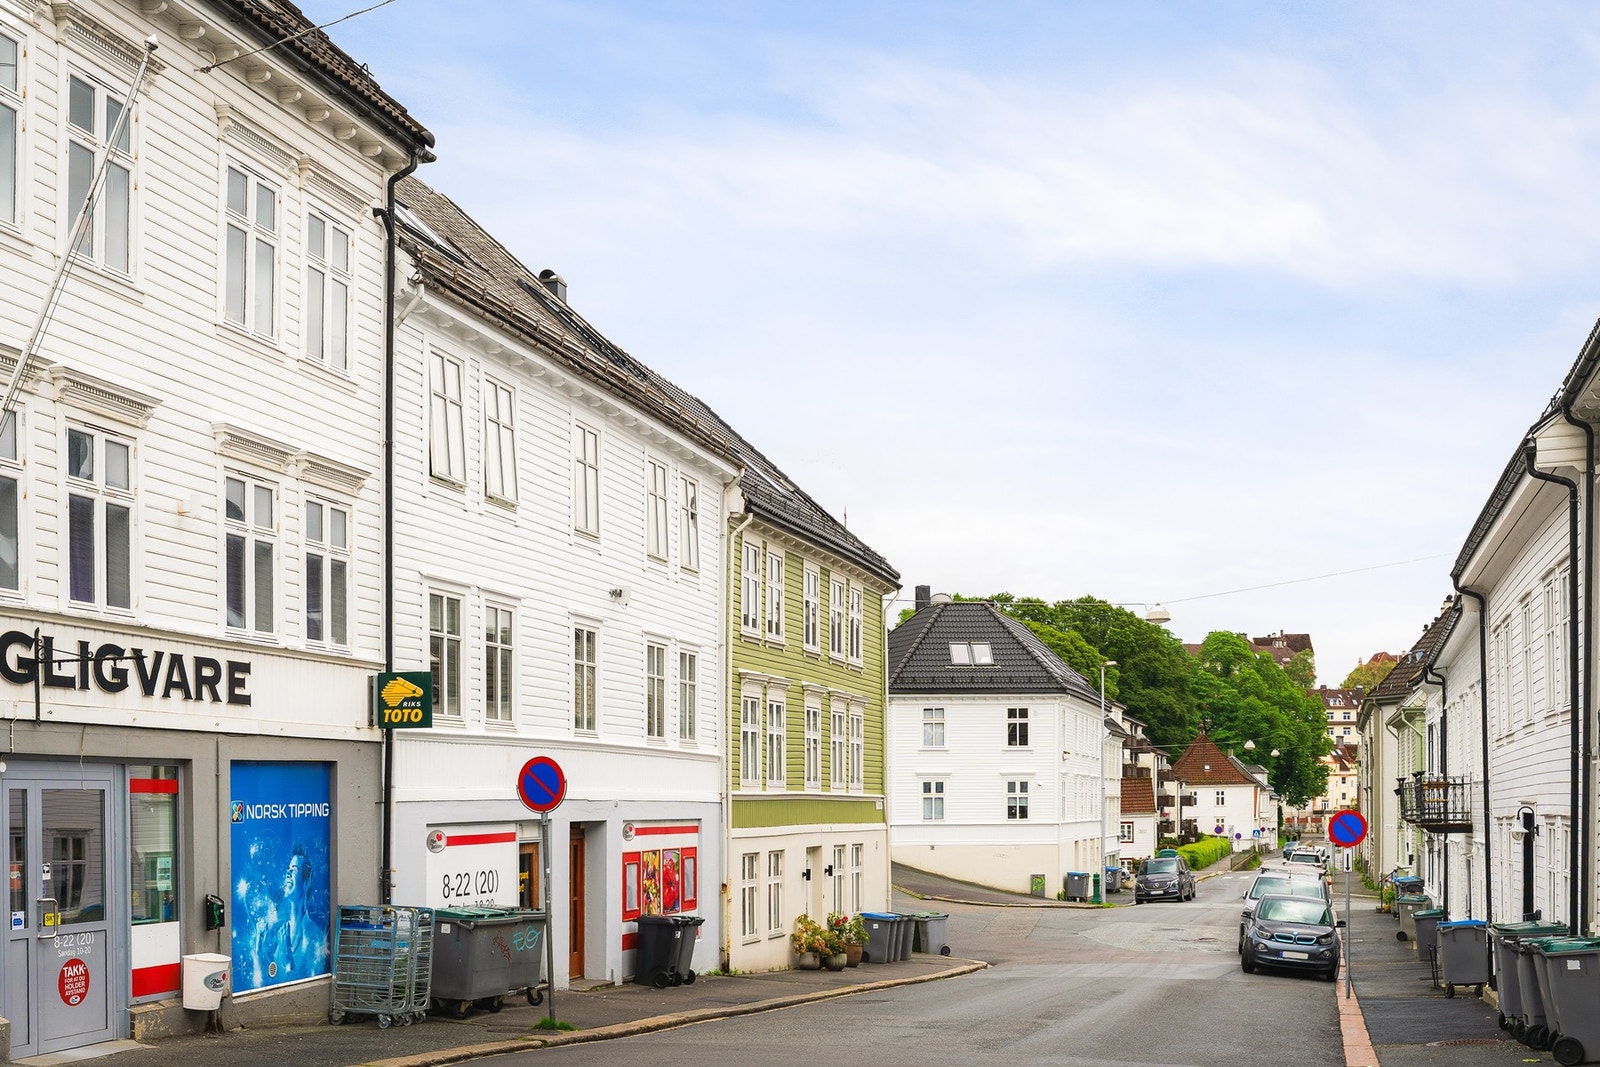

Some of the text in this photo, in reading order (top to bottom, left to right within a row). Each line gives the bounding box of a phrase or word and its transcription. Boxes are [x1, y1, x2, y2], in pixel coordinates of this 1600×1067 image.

[0, 630, 251, 707] GLIGVARE
[383, 708, 423, 723] TOTO
[246, 803, 329, 819] NORSK TIPPING
[442, 872, 471, 899] 8-22
[475, 869, 499, 895] (20)
[54, 932, 94, 949] 8-22 (20)
[64, 981, 86, 990] HOLDER
